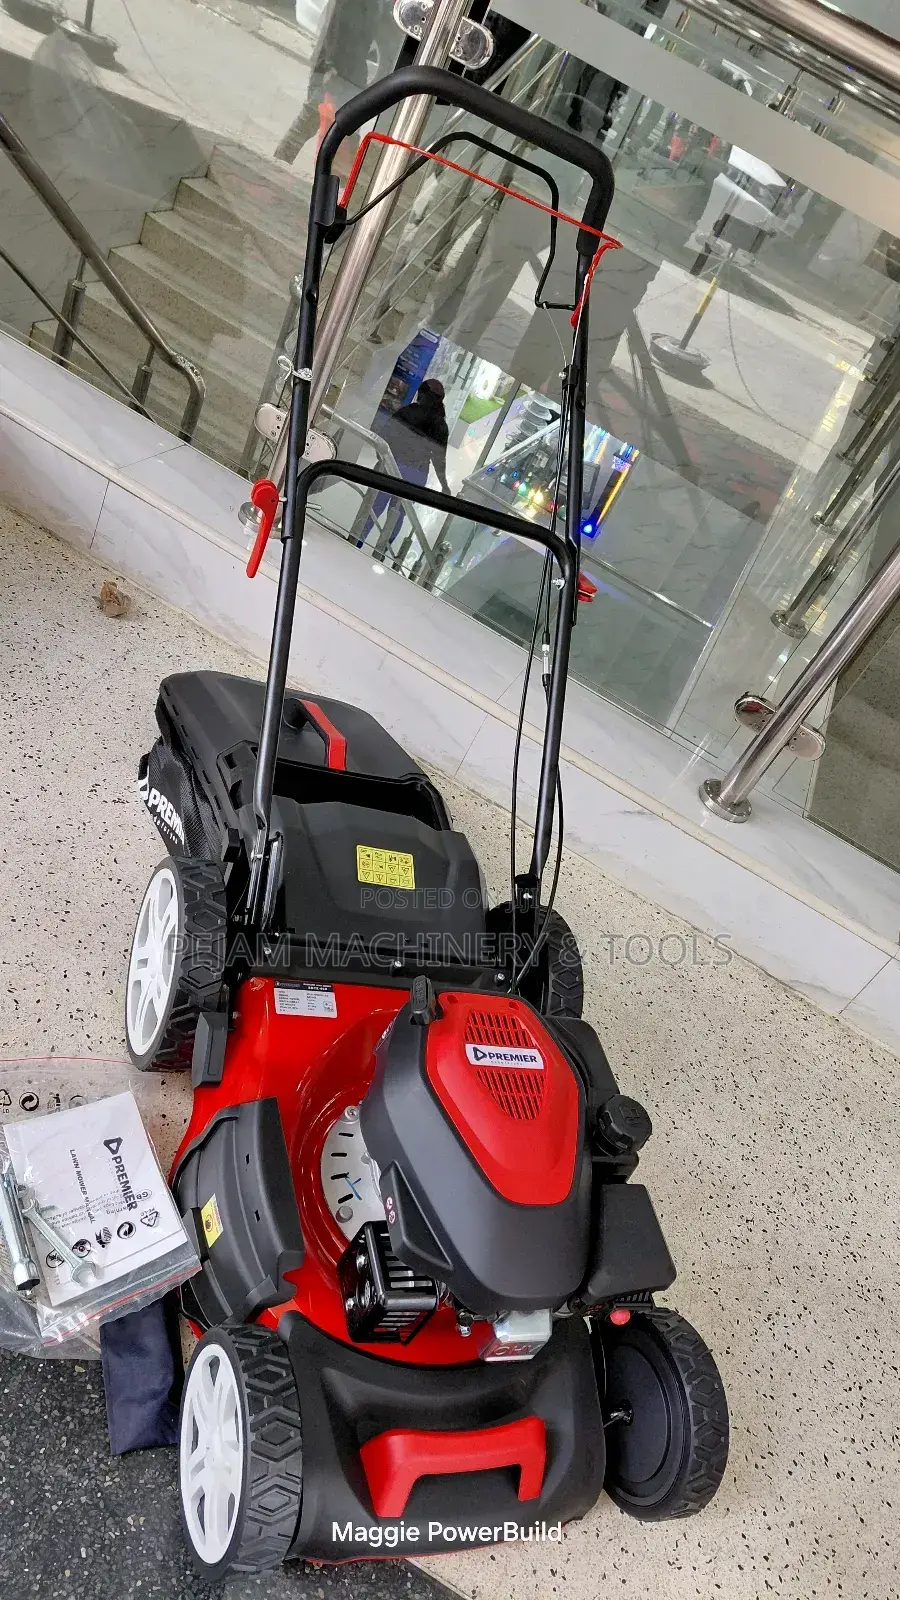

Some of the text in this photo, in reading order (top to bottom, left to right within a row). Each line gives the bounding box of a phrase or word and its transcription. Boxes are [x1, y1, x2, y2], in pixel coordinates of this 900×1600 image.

[487, 1051, 538, 1063] PREMIER
[69, 1149, 80, 1169] LAWN
[76, 1170, 88, 1196] MOWER
[111, 1155, 138, 1212] PREMIER
